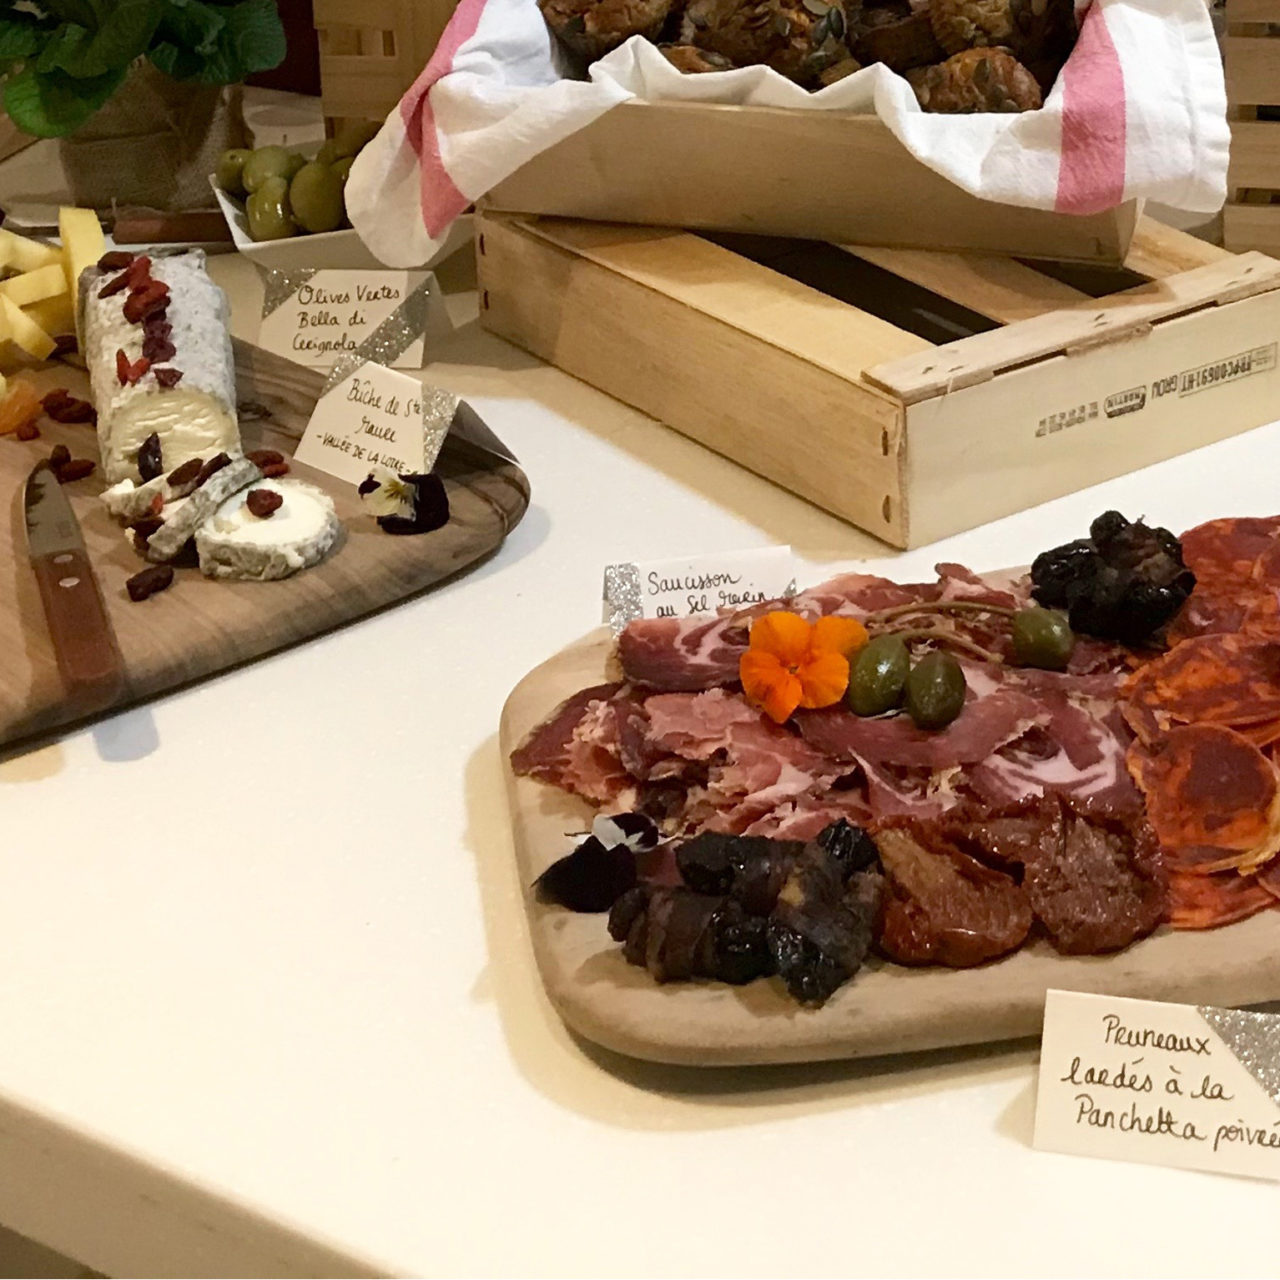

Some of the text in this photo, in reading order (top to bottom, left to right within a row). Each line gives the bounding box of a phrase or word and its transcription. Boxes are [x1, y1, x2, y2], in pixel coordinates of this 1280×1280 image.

[298, 285, 400, 305] Olives Vertes
[298, 309, 367, 329] Bella di
[292, 333, 358, 358] Cerignola
[347, 377, 382, 409] Bûche
[385, 396, 399, 416] de
[352, 445, 366, 460] DE
[367, 451, 379, 464] LA
[648, 572, 742, 596] Saucisson
[656, 606, 678, 617] au
[1102, 1014, 1212, 1055] Pruneaux
[1060, 1057, 1235, 1100] lardés à la
[1074, 1093, 1208, 1141] Panchetta
